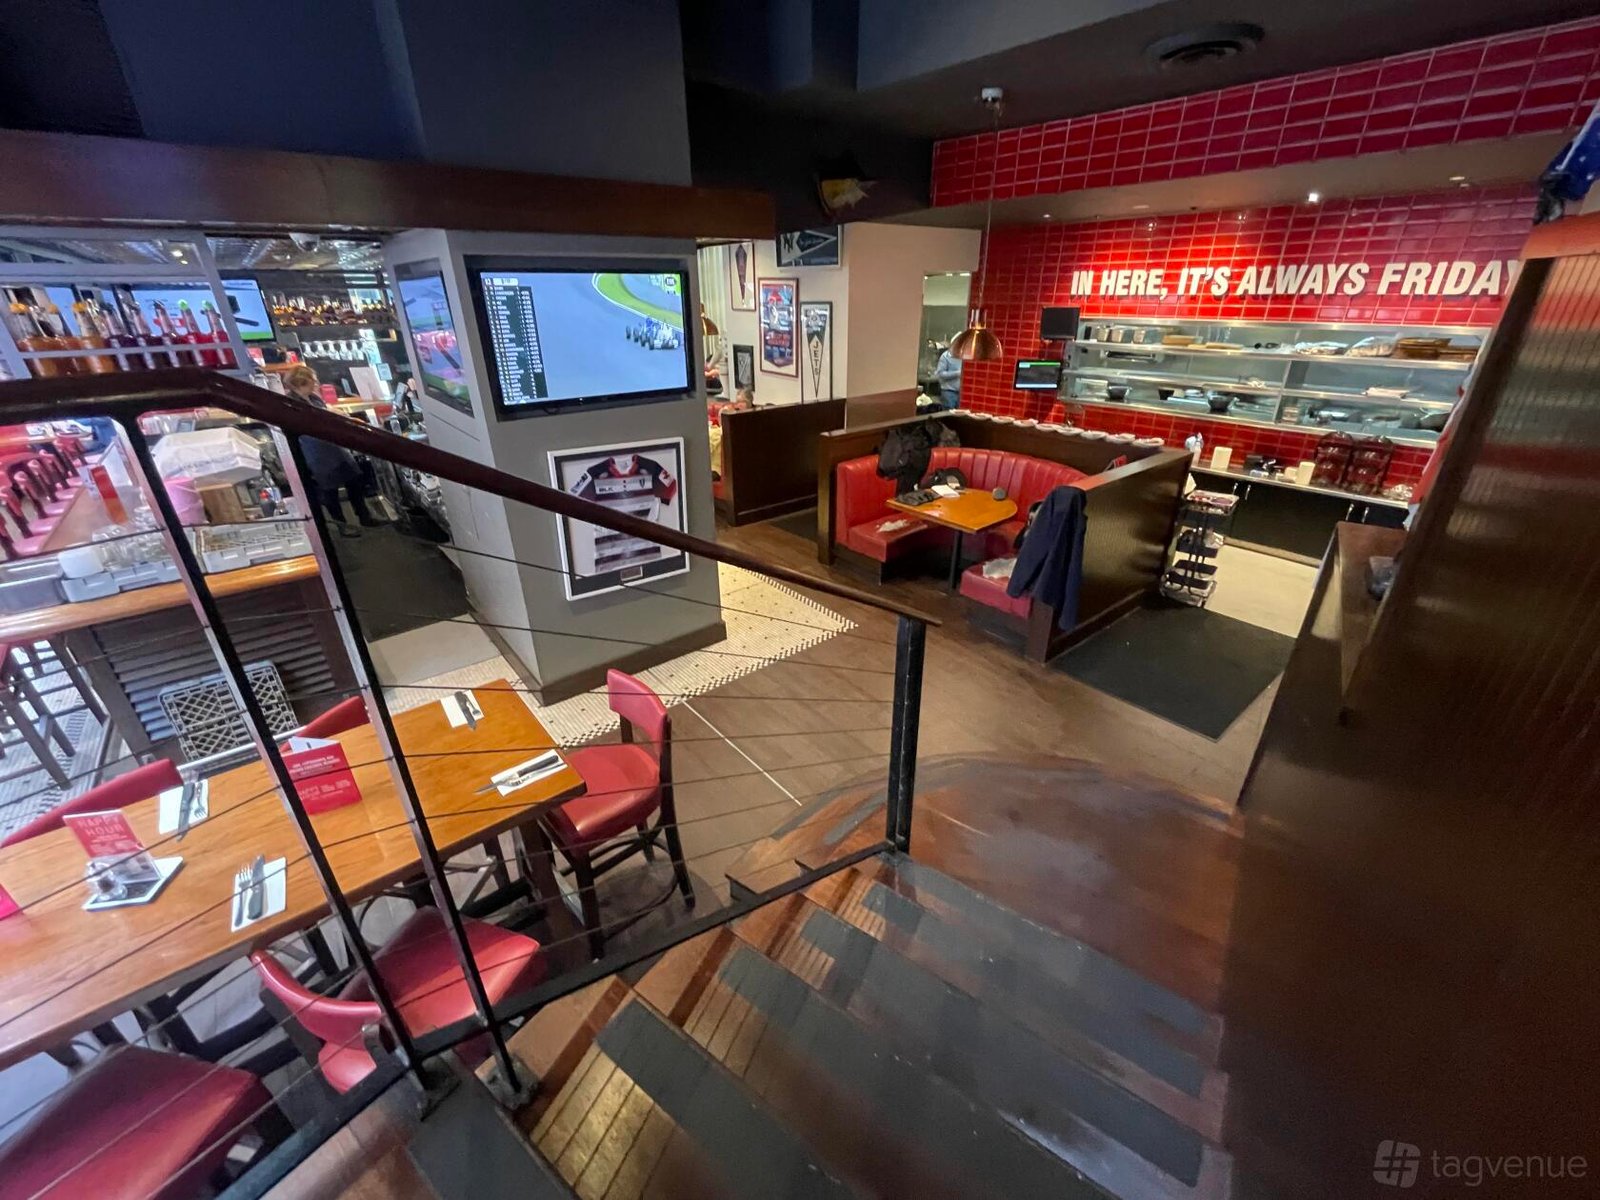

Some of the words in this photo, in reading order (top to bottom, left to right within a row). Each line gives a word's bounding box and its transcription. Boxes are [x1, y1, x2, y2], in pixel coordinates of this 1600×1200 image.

[1070, 270, 1094, 296] IN
[1100, 269, 1169, 300] HERE,
[1177, 266, 1231, 296] IT'S
[1236, 263, 1370, 296] ALWAYS
[77, 815, 119, 828] HAPPY
[85, 823, 125, 837] HOUR
